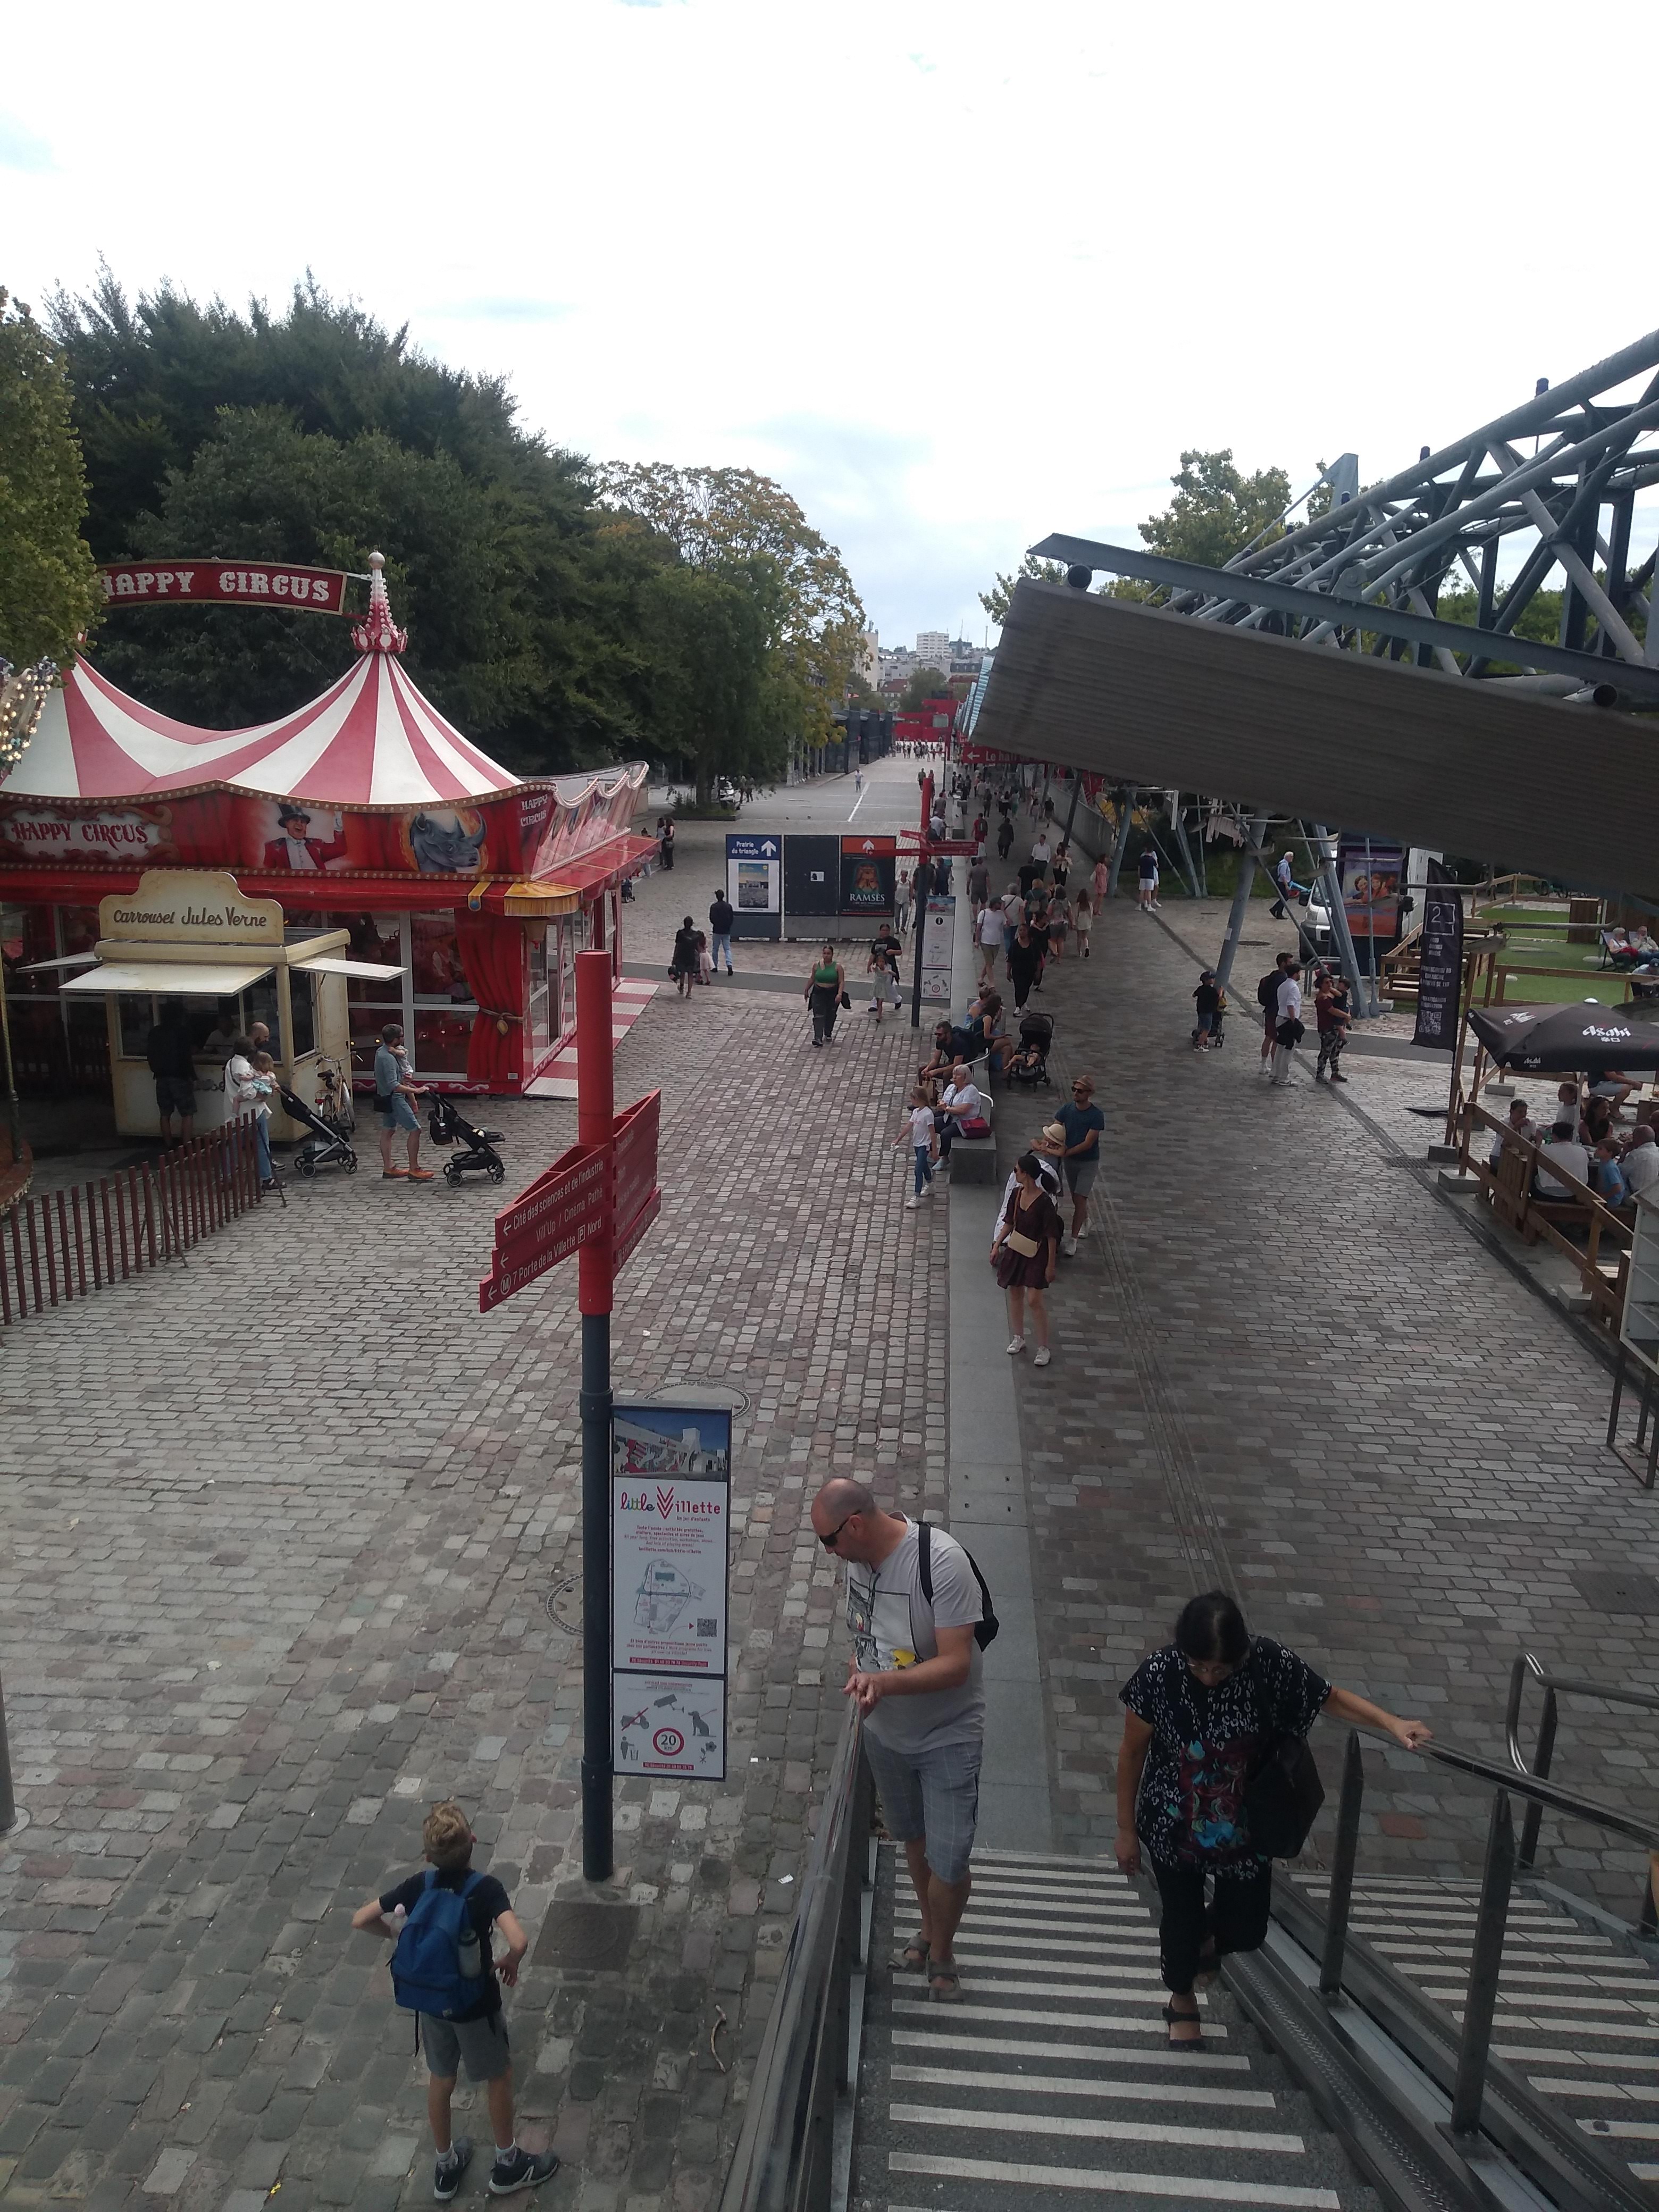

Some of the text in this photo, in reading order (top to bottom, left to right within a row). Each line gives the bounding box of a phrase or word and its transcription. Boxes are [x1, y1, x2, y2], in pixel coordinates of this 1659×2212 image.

[219, 572, 330, 601] CIRCUS
[986, 751, 996, 761] Le
[521, 794, 548, 810] HAPPY
[521, 809, 546, 827] CIRCUS
[11, 822, 148, 851] HAPPY CIRCUS
[113, 906, 267, 927] Carrousel Jules Verne
[1582, 1025, 1631, 1037] Asahi
[514, 1209, 526, 1230] Cité
[539, 1189, 564, 1212] sciences
[565, 1183, 571, 1195] et
[571, 1177, 578, 1191] de
[579, 1159, 604, 1185] l'industrie
[564, 1200, 585, 1222] Cinéma
[588, 1184, 602, 1205] Pathé
[513, 1271, 517, 1285] 7
[519, 1263, 538, 1282] Porte
[539, 1256, 546, 1269] de
[547, 1249, 553, 1263] la
[554, 1235, 576, 1258] Villette
[588, 1216, 602, 1235] Nord
[621, 1486, 721, 1520] little Villette
[660, 1735, 676, 1746] 20
